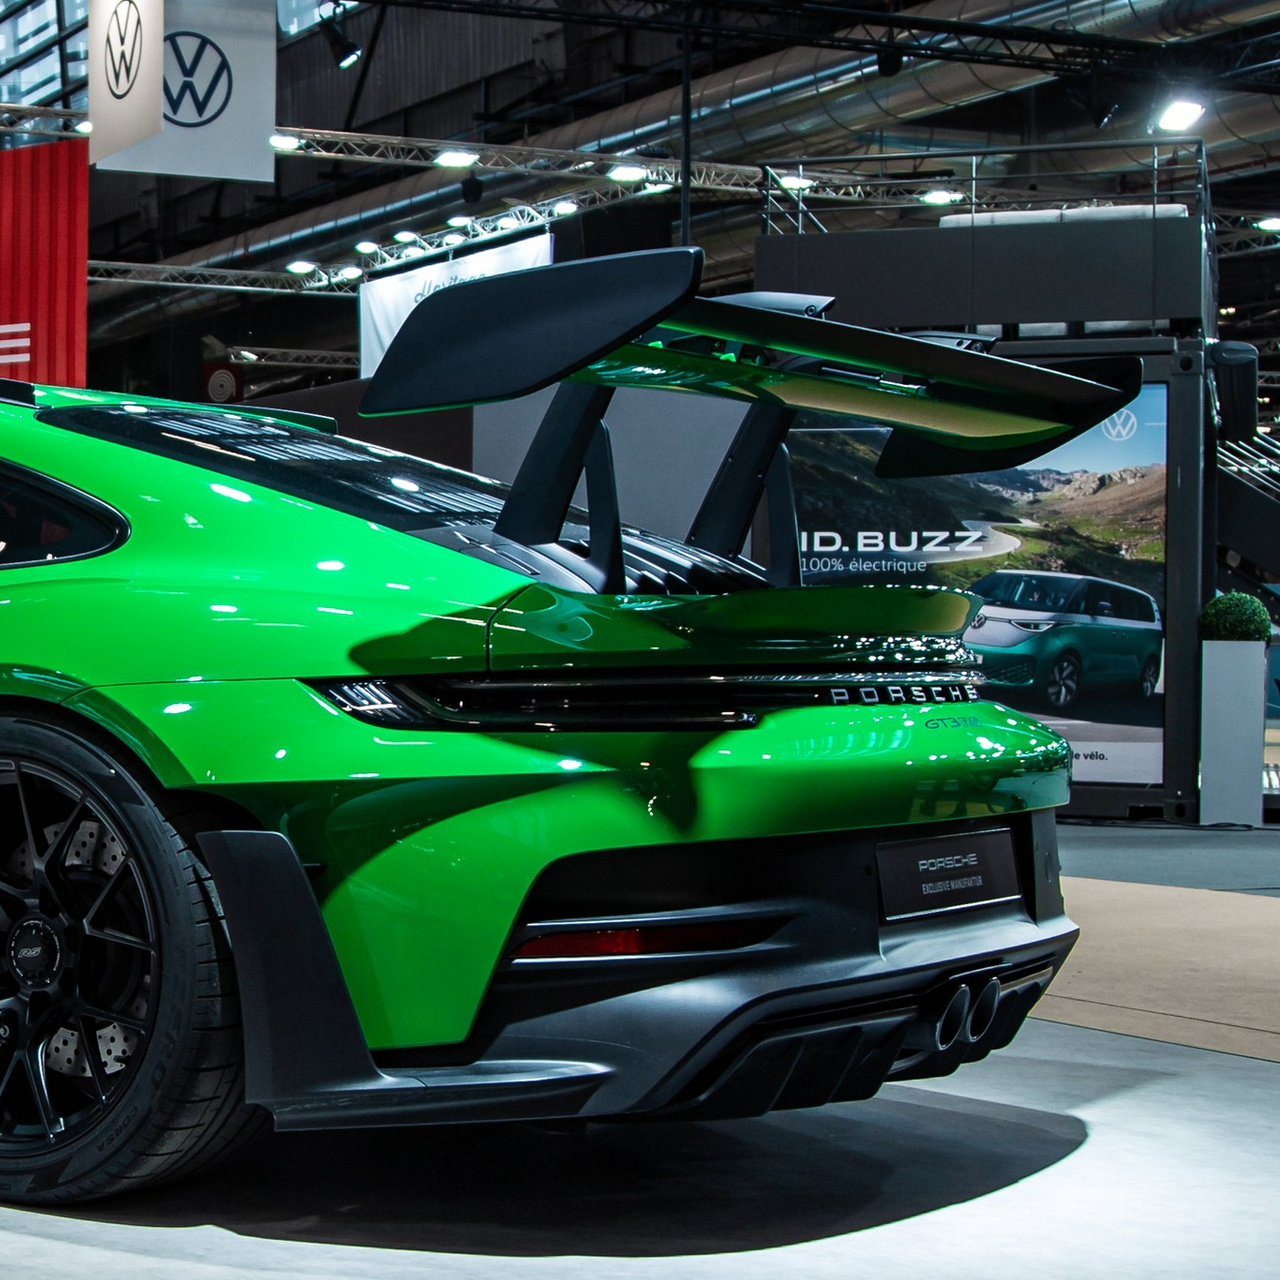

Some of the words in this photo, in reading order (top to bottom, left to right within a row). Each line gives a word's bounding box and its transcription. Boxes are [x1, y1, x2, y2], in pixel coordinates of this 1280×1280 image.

[857, 531, 984, 552] BUZZ
[801, 557, 845, 572] 100%
[849, 556, 927, 575] électrique
[830, 684, 979, 706] PORSCHE
[1083, 750, 1108, 761] vélo.
[918, 853, 978, 872] PORSCHE
[17, 946, 42, 959] RS
